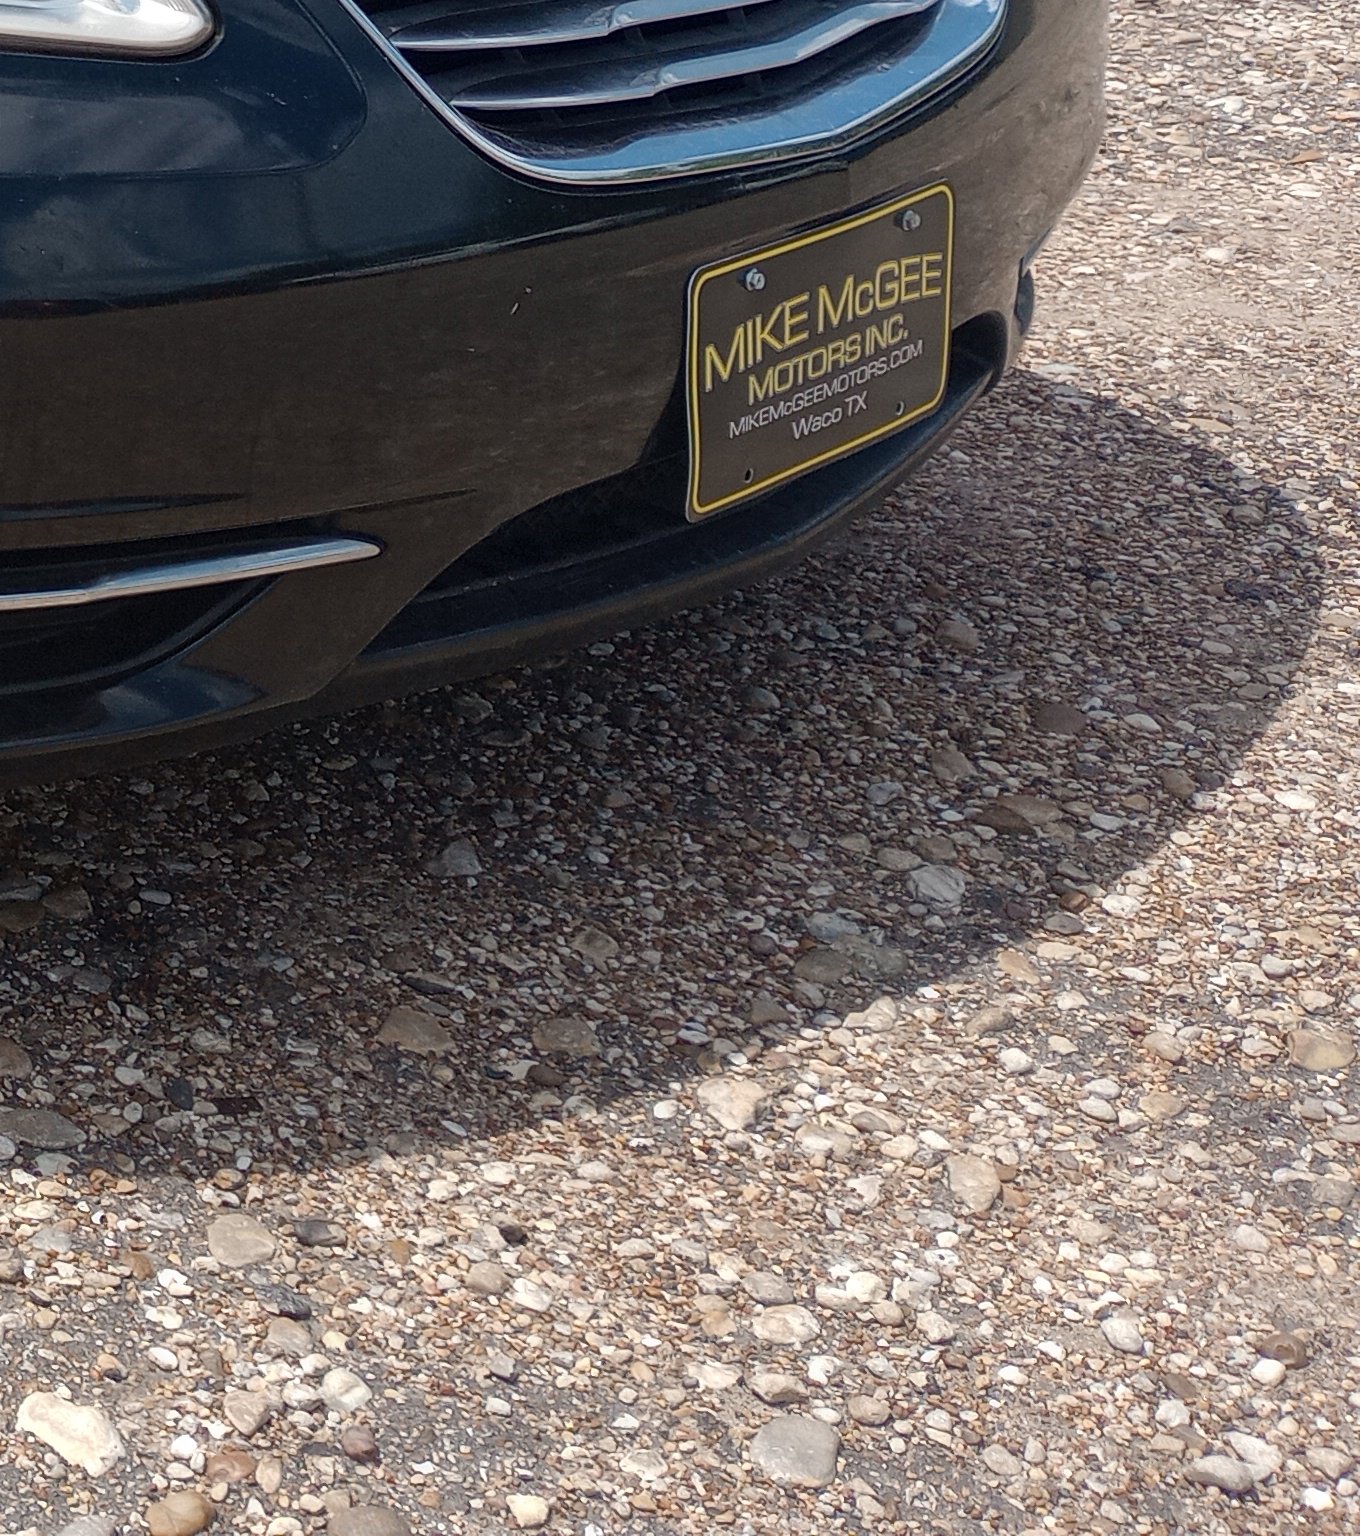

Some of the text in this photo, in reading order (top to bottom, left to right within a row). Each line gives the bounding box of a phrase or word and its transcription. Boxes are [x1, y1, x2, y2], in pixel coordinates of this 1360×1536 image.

[704, 290, 811, 392] MIKE
[748, 312, 909, 406] MOTORS INC.
[791, 391, 869, 440] Waco TX
